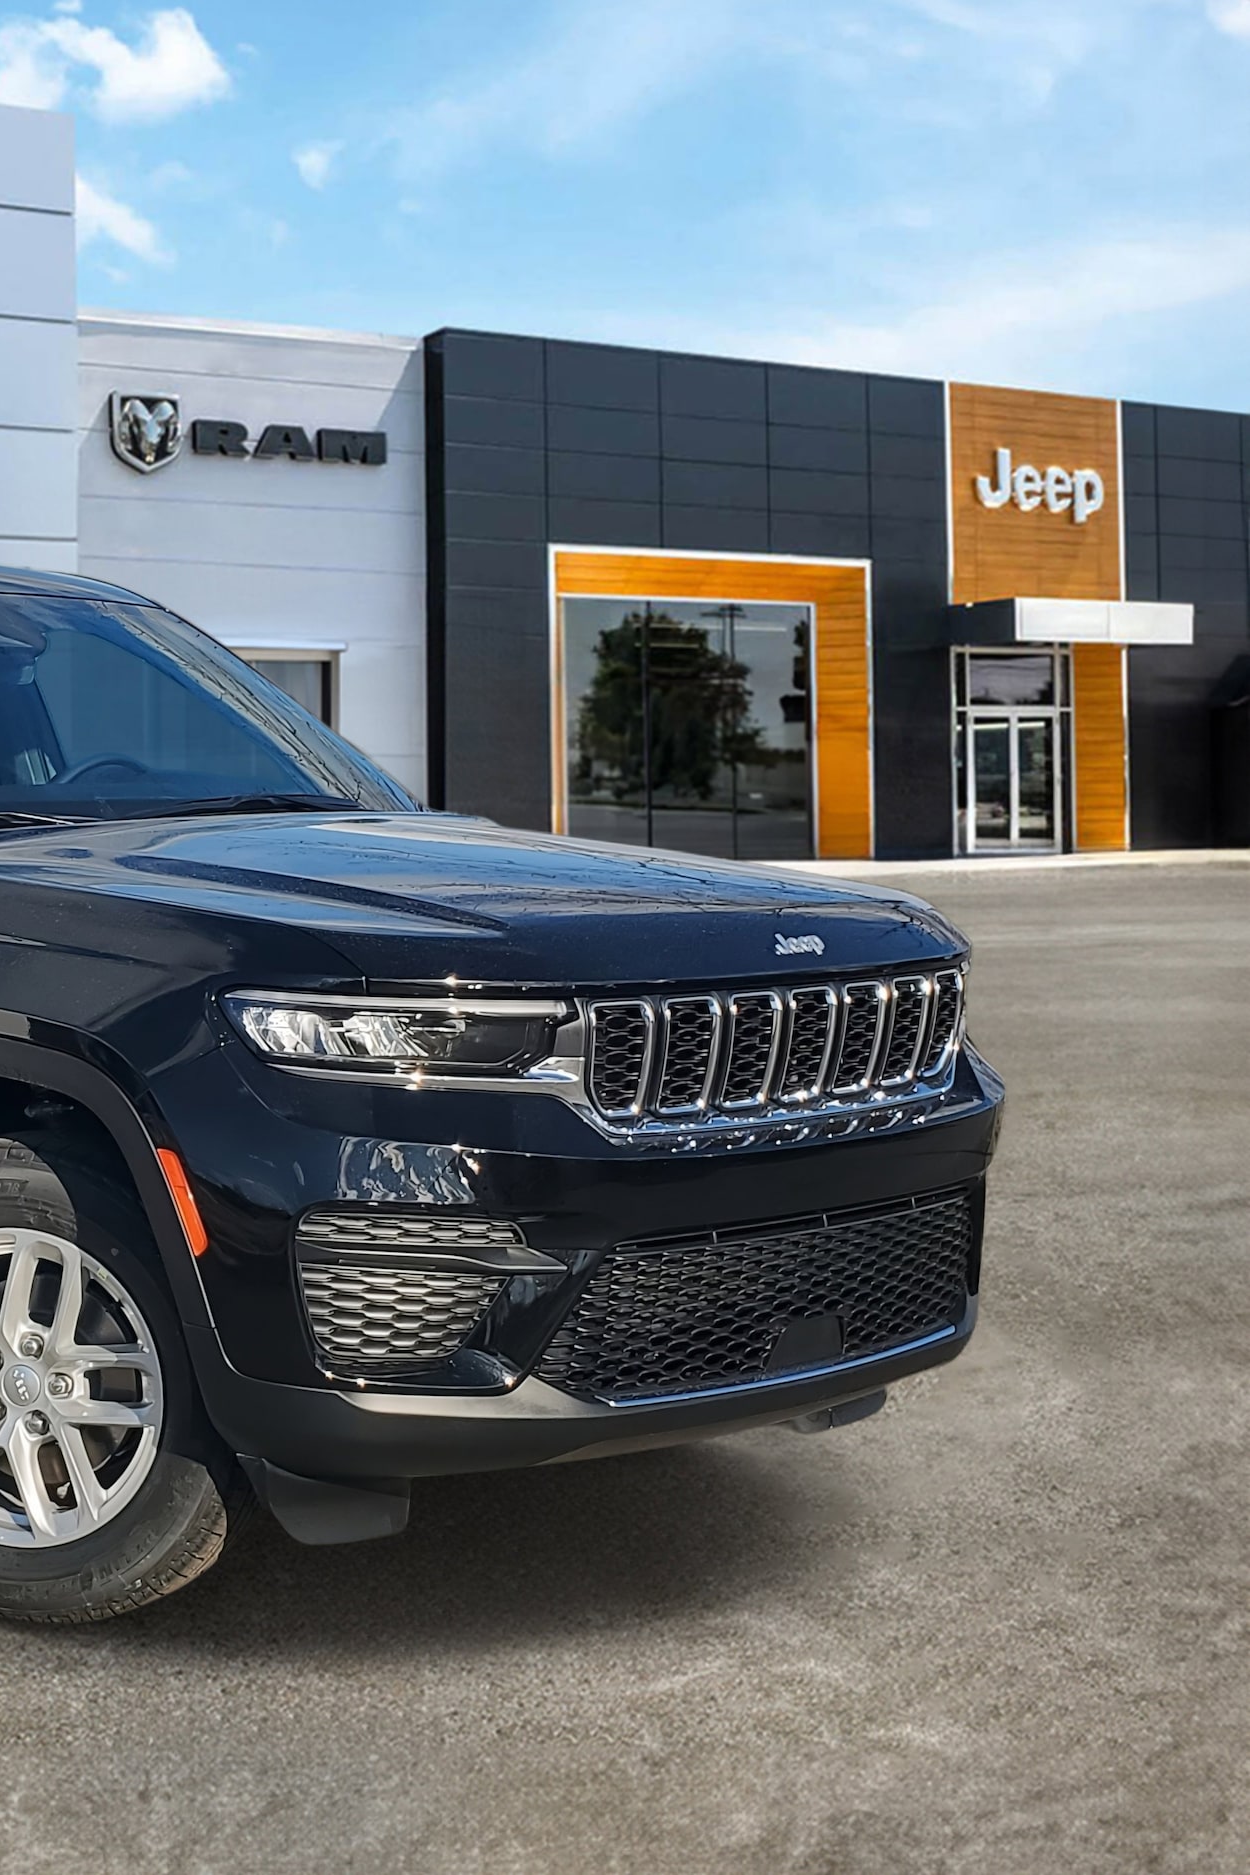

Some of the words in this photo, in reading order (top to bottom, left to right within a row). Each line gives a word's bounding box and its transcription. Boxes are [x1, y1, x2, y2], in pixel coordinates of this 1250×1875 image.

[191, 419, 387, 465] RAM
[975, 447, 1103, 523] Jeep
[774, 933, 825, 955] Jeep
